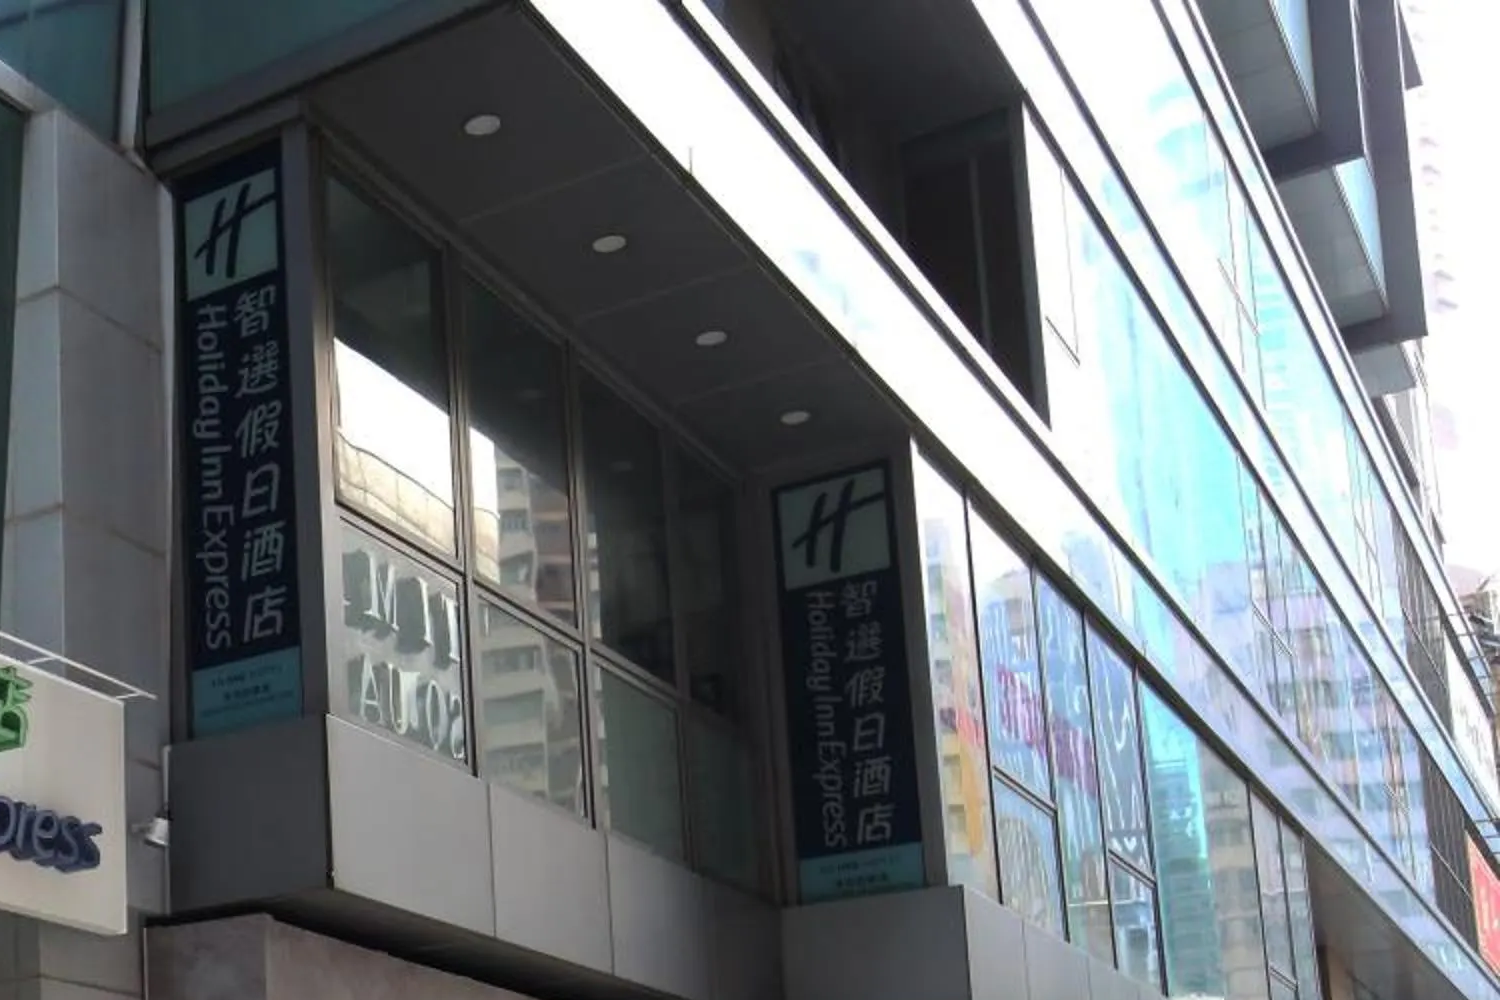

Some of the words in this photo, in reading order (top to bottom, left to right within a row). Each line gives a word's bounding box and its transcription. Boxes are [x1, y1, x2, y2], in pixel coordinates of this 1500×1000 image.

[192, 305, 230, 440] Holiday
[201, 444, 233, 500] Inn
[234, 283, 289, 644] 智選假日酒店
[195, 501, 235, 651] Express
[803, 590, 837, 693] Holiday
[813, 697, 843, 738] Inn
[840, 580, 897, 846] 智選假日酒店
[812, 741, 847, 849] Express
